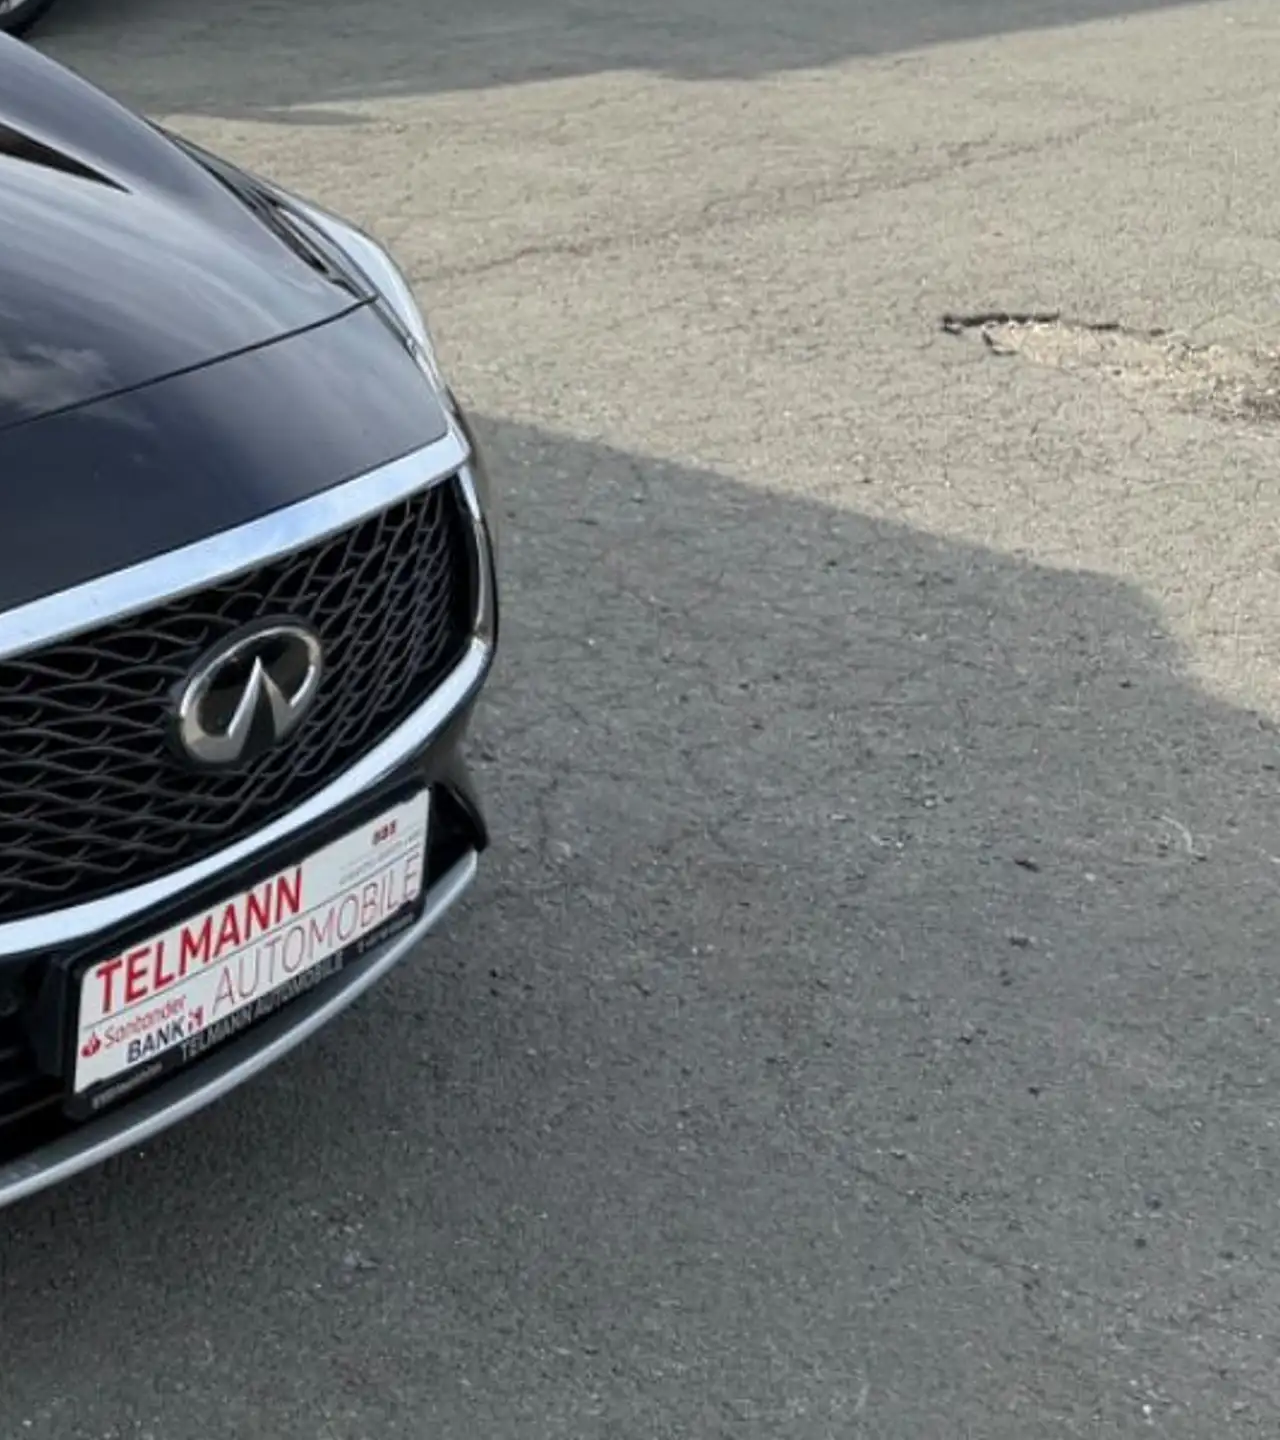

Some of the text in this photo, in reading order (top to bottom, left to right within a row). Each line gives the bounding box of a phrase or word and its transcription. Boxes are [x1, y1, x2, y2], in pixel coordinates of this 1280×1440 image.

[96, 866, 303, 1014] TELMANN
[211, 851, 421, 1017] AUTOMOBILE
[103, 993, 186, 1050] Santander
[126, 1016, 186, 1064] BANK
